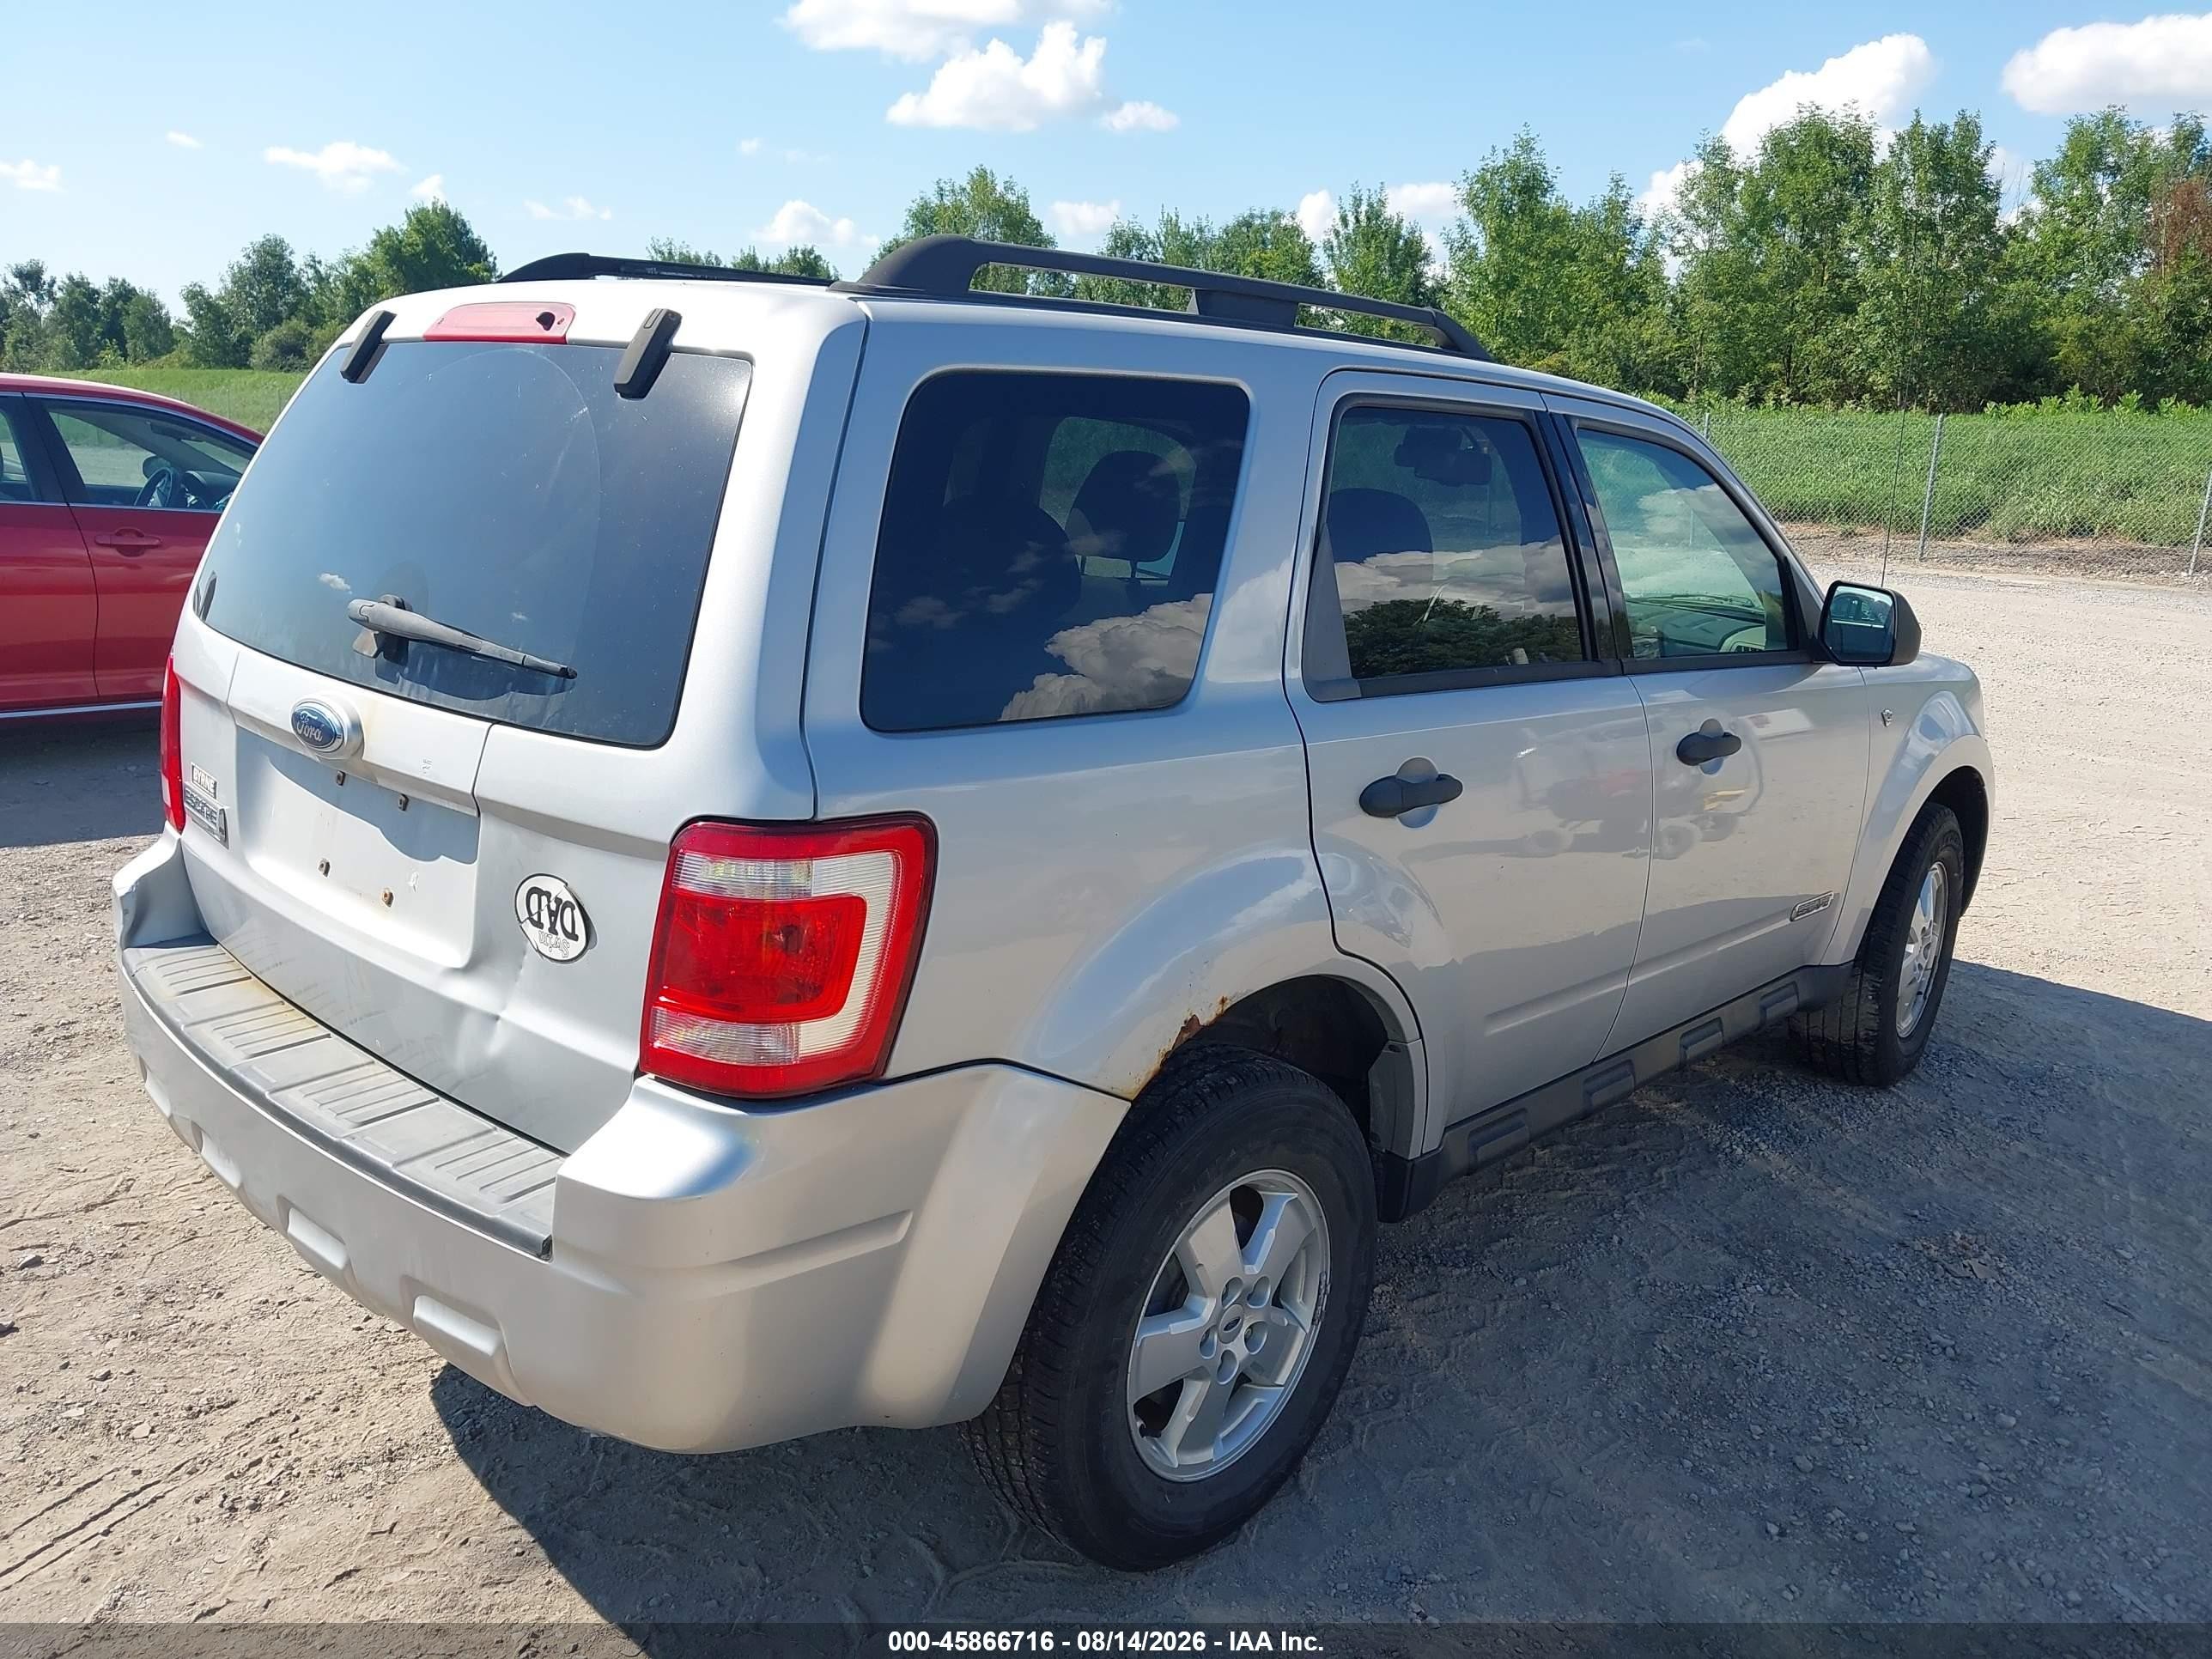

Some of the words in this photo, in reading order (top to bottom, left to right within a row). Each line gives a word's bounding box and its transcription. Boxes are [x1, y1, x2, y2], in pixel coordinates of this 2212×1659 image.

[296, 710, 325, 742] Ford
[192, 768, 216, 793] BYRNE
[526, 886, 579, 942] DAD
